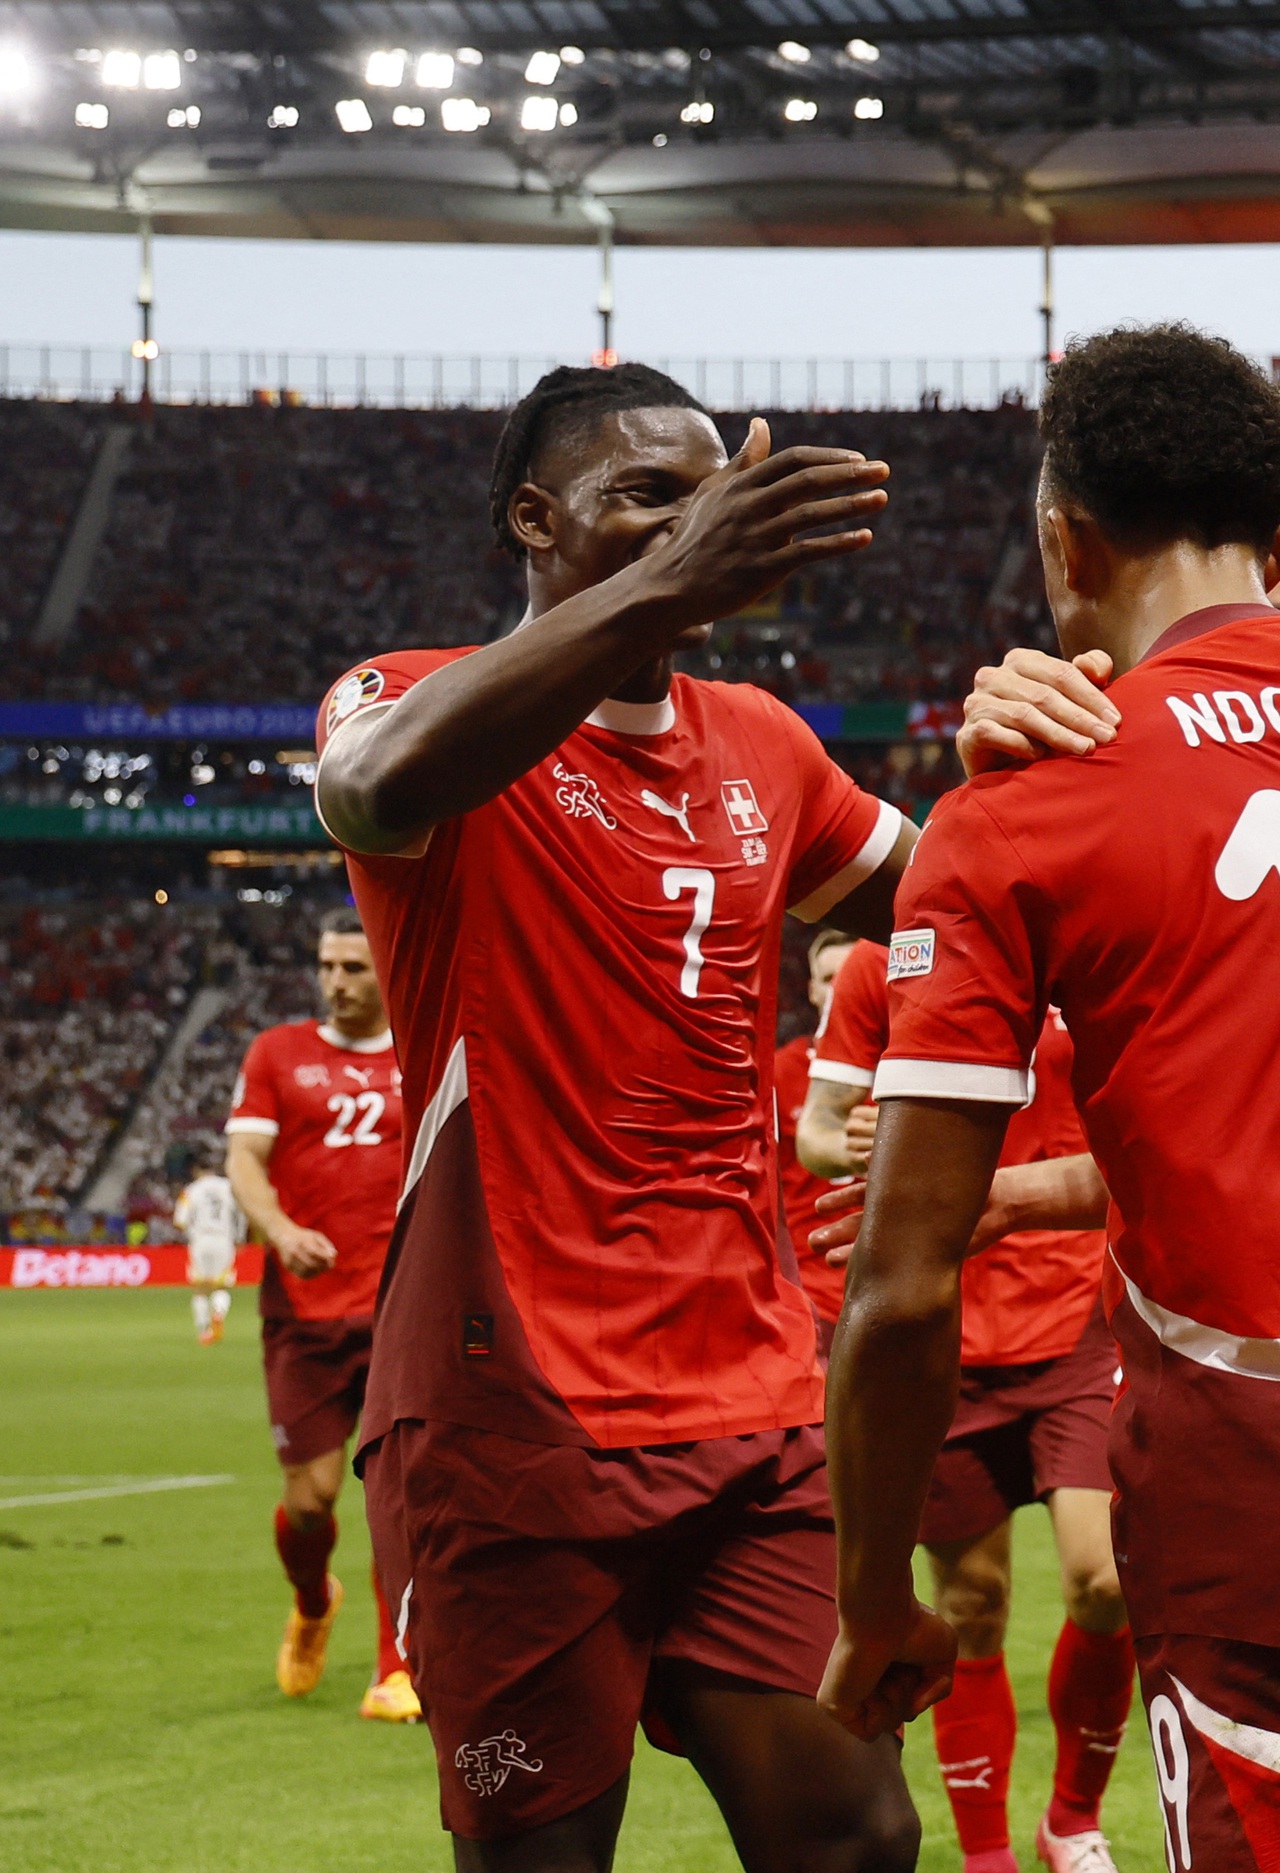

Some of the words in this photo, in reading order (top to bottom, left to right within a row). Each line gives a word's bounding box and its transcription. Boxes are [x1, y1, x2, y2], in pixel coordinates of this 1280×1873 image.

[260, 708, 317, 734] 202
[83, 809, 311, 835] FRANKFURT
[662, 867, 716, 999] 7
[323, 1091, 386, 1148] 22
[11, 1249, 151, 1288] Betano
